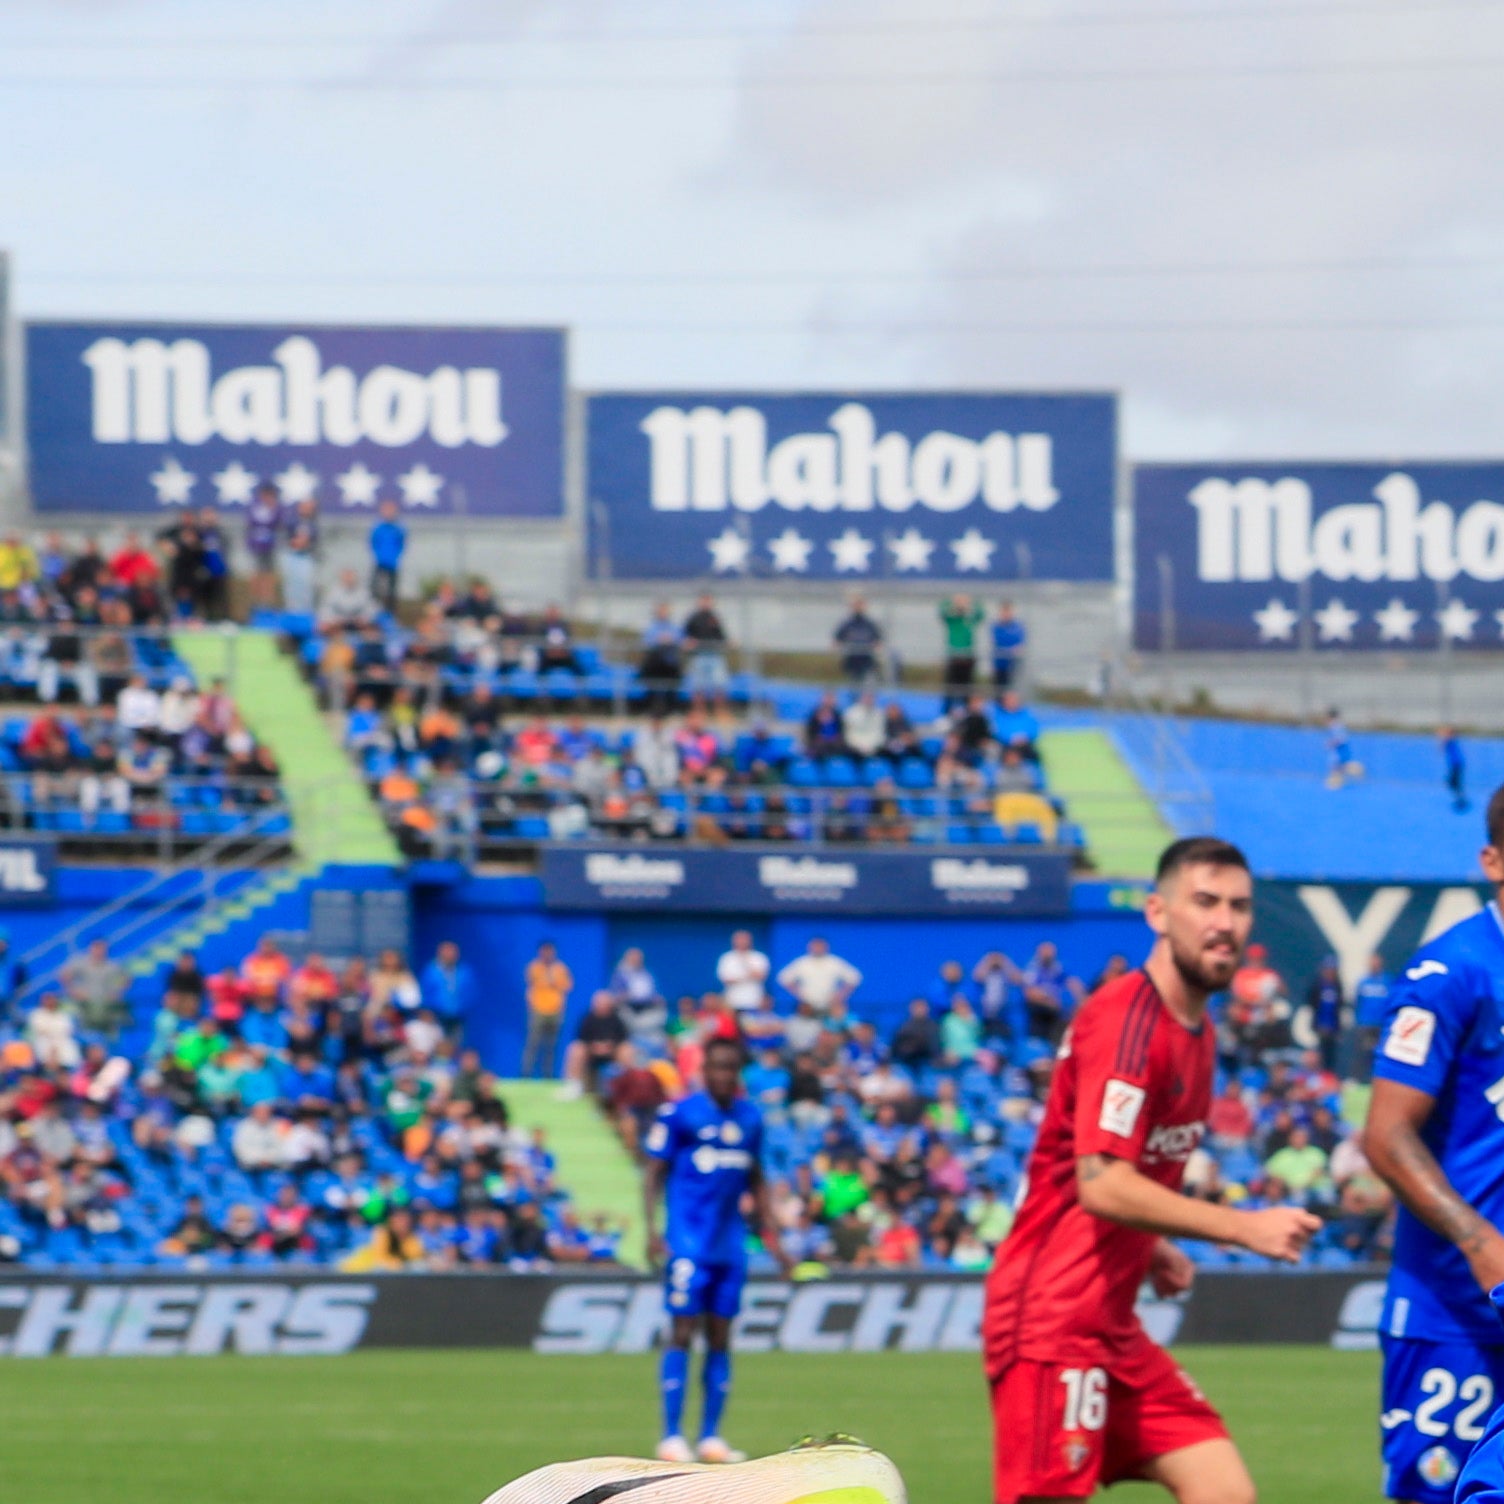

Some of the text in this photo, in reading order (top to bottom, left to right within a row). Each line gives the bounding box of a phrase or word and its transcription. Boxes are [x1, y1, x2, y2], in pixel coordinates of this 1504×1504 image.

[82, 336, 508, 446] Mahou
[640, 402, 1060, 512] Mahou
[585, 853, 684, 886] Mahou
[758, 856, 857, 890] Mahou
[931, 858, 1029, 891] Mahou
[1061, 1367, 1108, 1431] 16
[1414, 1367, 1494, 1441] 22
